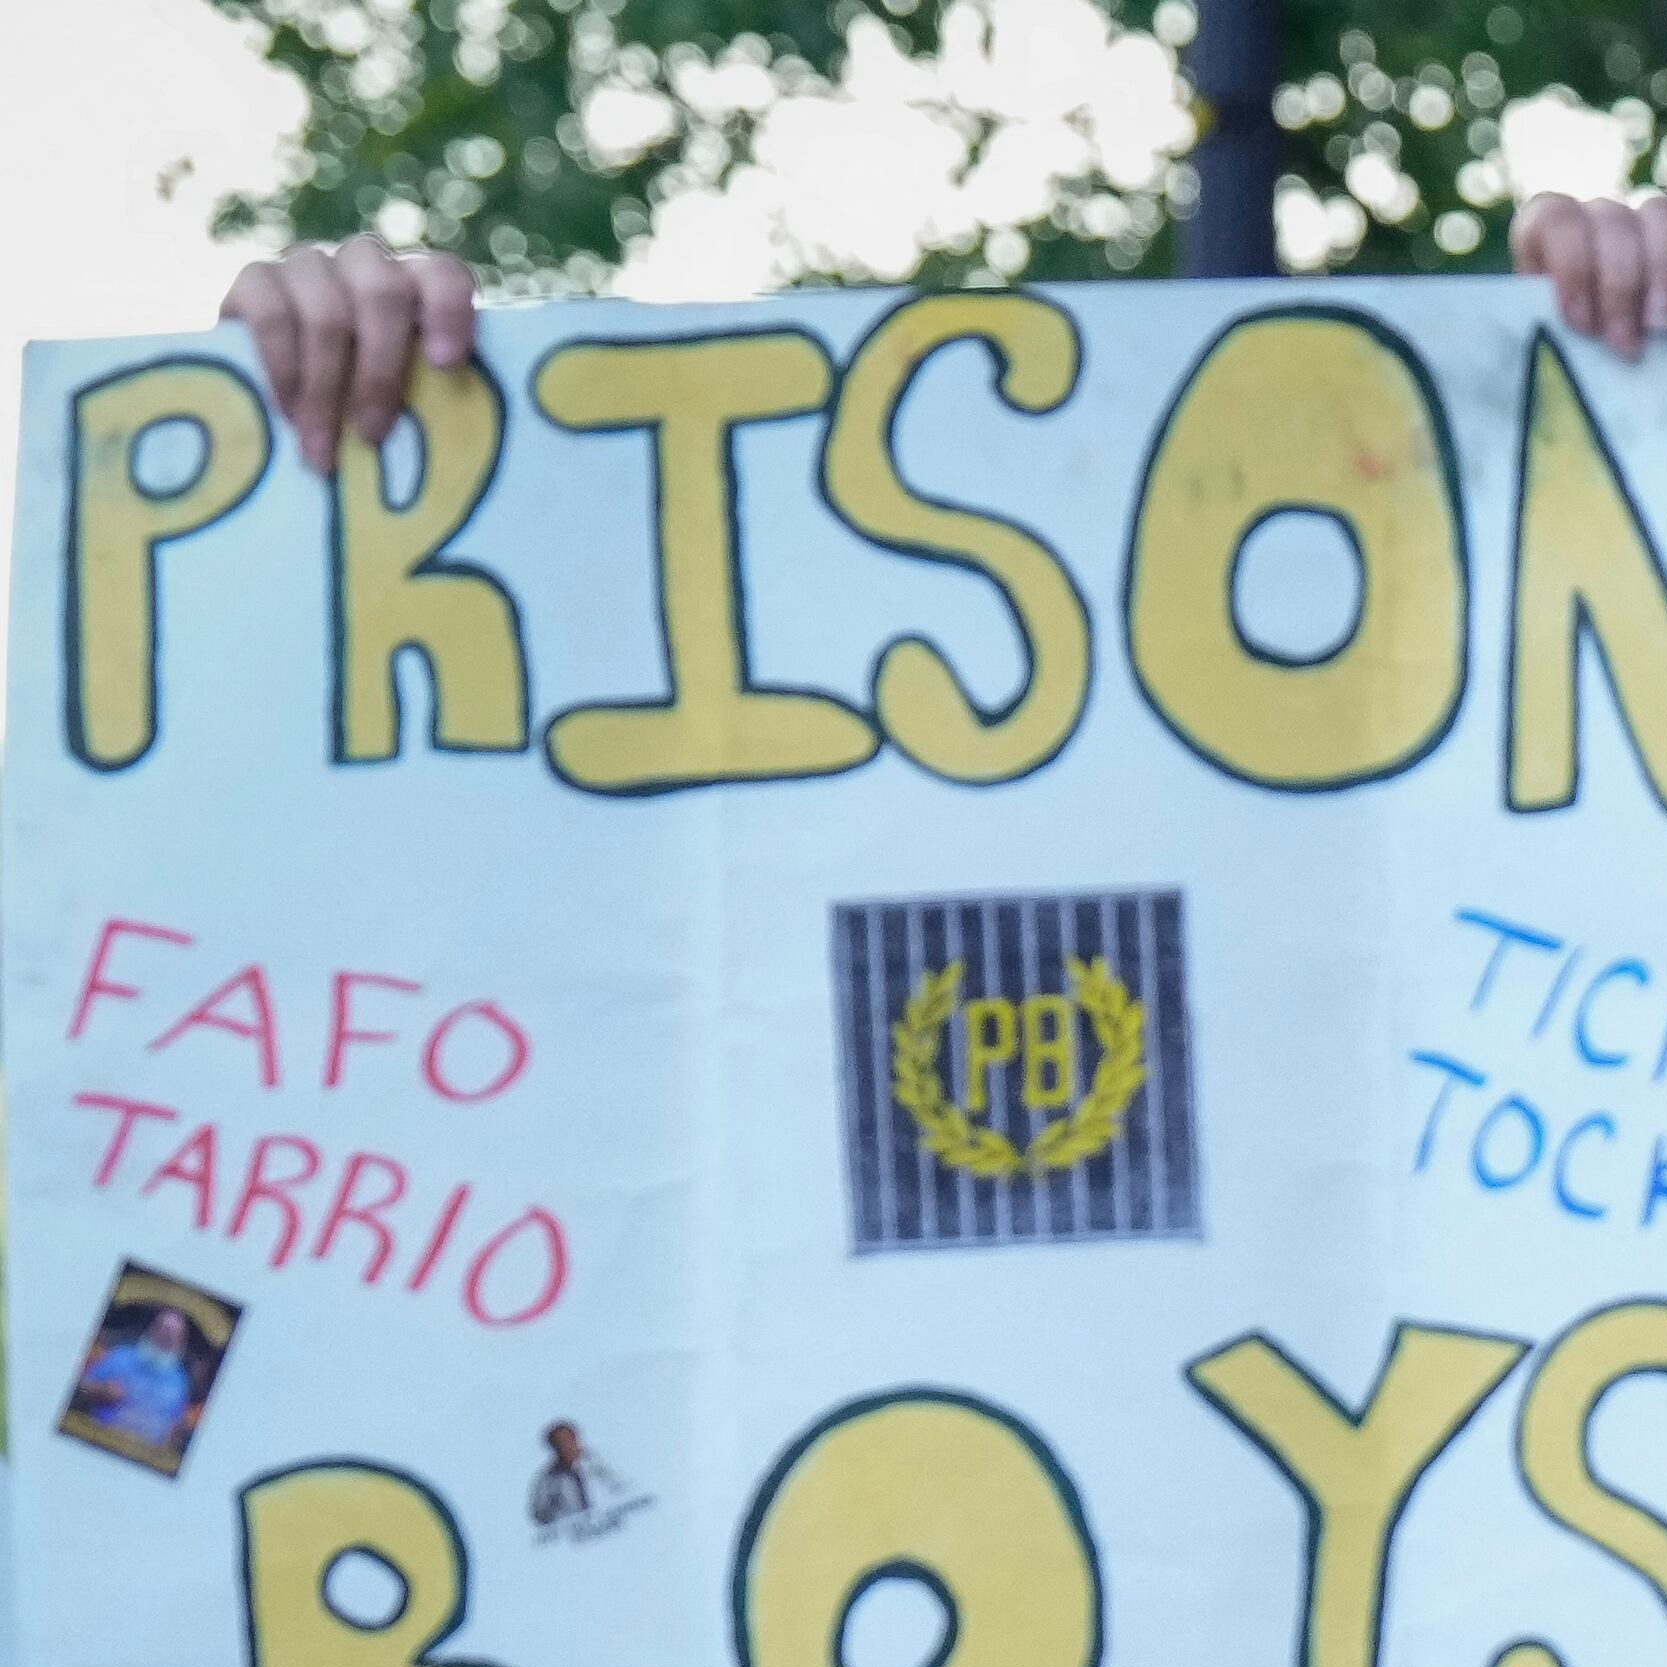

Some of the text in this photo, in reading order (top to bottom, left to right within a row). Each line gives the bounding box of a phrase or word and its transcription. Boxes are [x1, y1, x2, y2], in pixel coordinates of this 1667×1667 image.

[66, 916, 531, 1104] FAFO
[965, 992, 1075, 1112] PB
[71, 1091, 572, 1328] TARRIO
